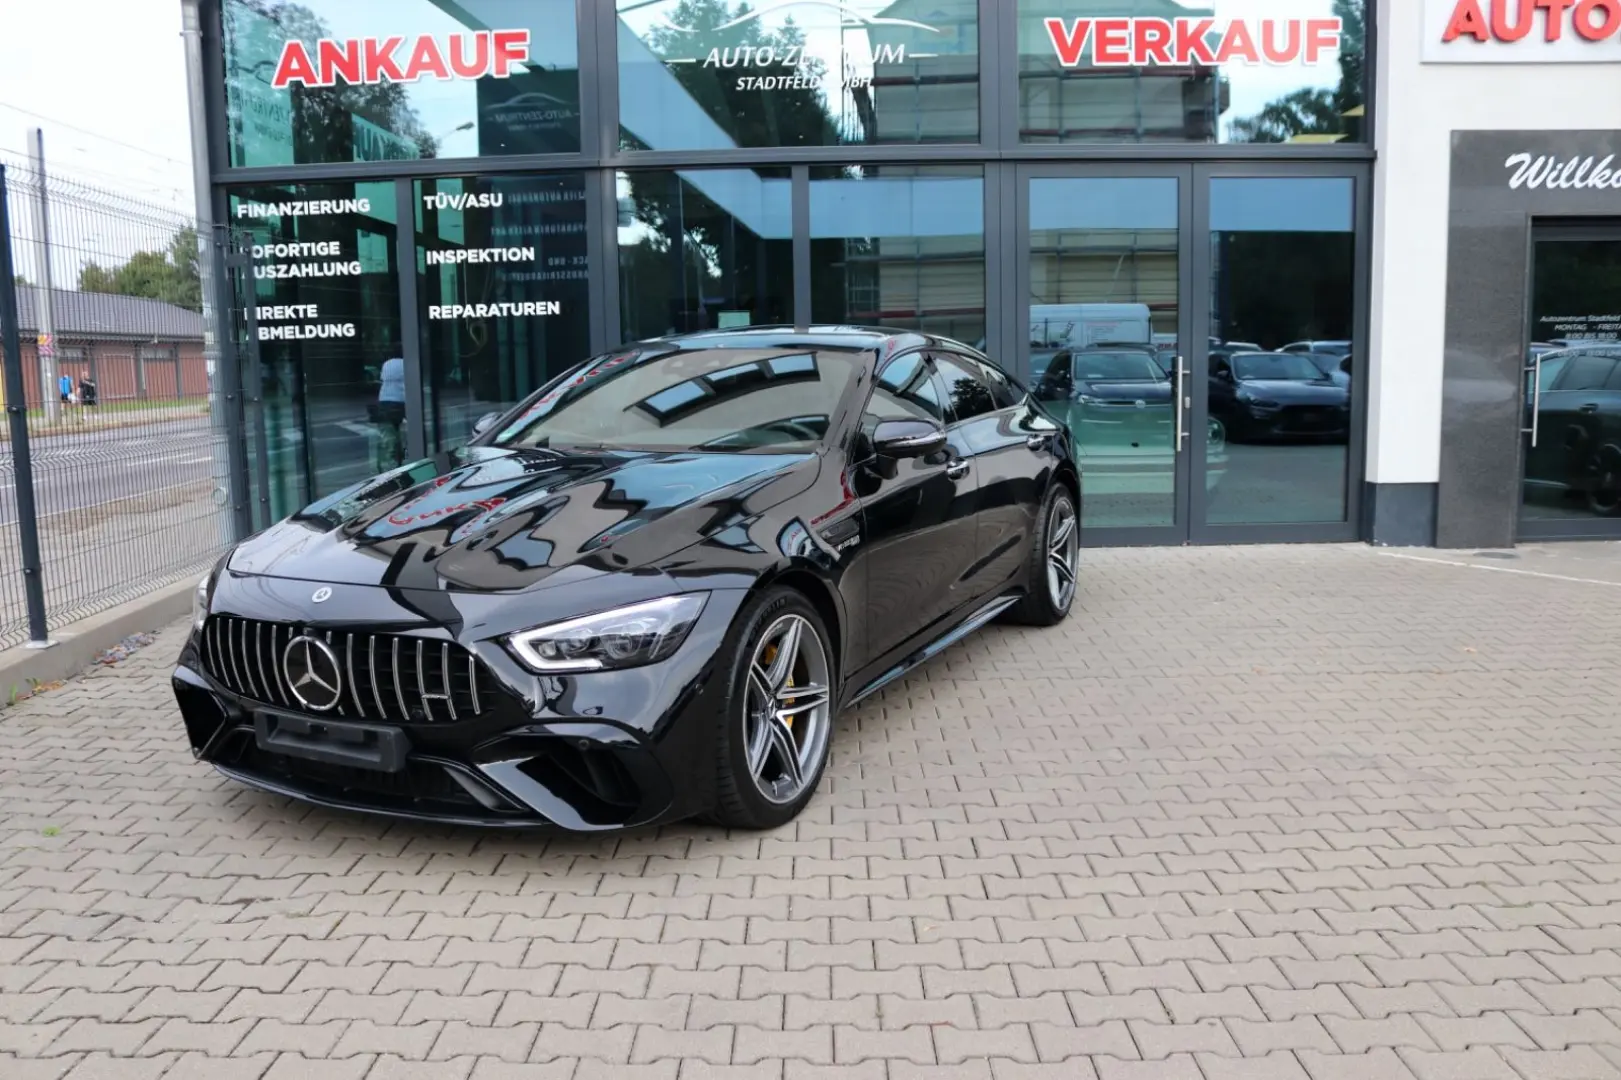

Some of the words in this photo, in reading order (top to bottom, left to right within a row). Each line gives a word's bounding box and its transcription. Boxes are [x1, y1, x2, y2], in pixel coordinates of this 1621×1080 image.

[1441, 0, 1621, 42] AUTO
[1044, 16, 1342, 67] VERKAUF
[272, 29, 530, 88] ANKAUF
[736, 76, 820, 91] STADTFELD
[237, 198, 371, 219] FINANZIERUNG
[423, 192, 503, 211] TÜV/ASU
[240, 241, 341, 259] OFORTIGE
[427, 246, 535, 265] INSPEKTION
[241, 260, 362, 280] USZAHLUNG
[429, 300, 560, 320] REPARATUREN
[246, 323, 356, 341] BMELDUNG
